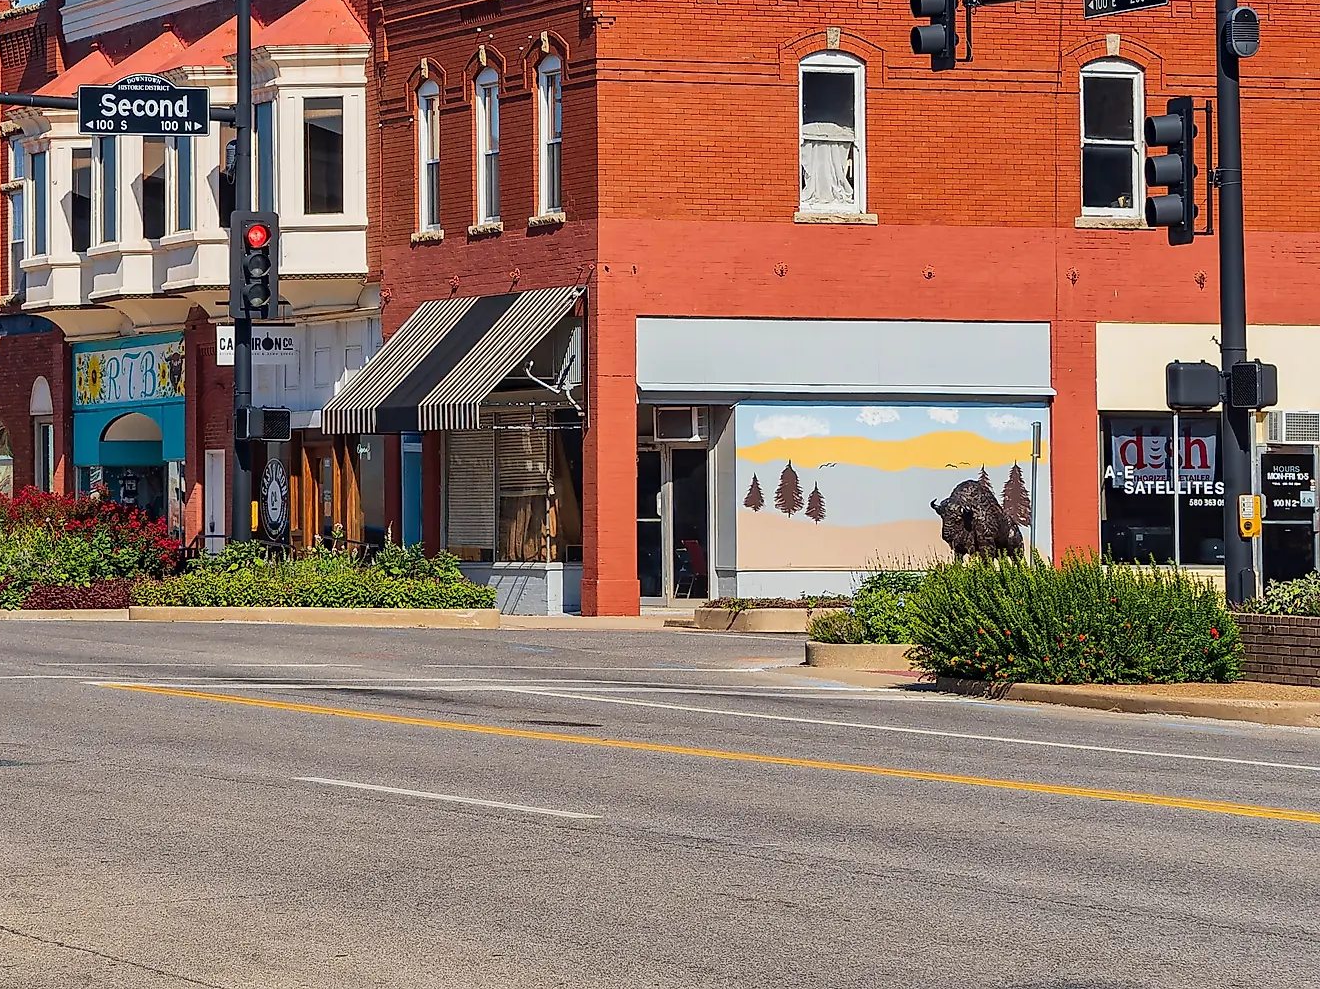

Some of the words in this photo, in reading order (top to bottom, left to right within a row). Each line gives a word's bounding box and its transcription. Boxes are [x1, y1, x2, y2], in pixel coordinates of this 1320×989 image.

[126, 75, 162, 85] DOWNTOWN
[100, 93, 188, 117] Second
[95, 120, 114, 130] 100
[120, 120, 128, 131] S
[161, 121, 178, 131] 100
[184, 121, 192, 131] N
[220, 338, 234, 350] CA
[252, 337, 282, 351] IRON
[106, 351, 157, 400] RTB
[1104, 465, 1135, 479] A-E
[1267, 472, 1296, 480] MON-FRI
[261, 463, 272, 496] CAST
[276, 463, 288, 497] IRON
[1123, 481, 1225, 495] SATELLITES
[1189, 498, 1203, 506] 580
[1272, 499, 1285, 508] 100
[1285, 499, 1291, 507] N
